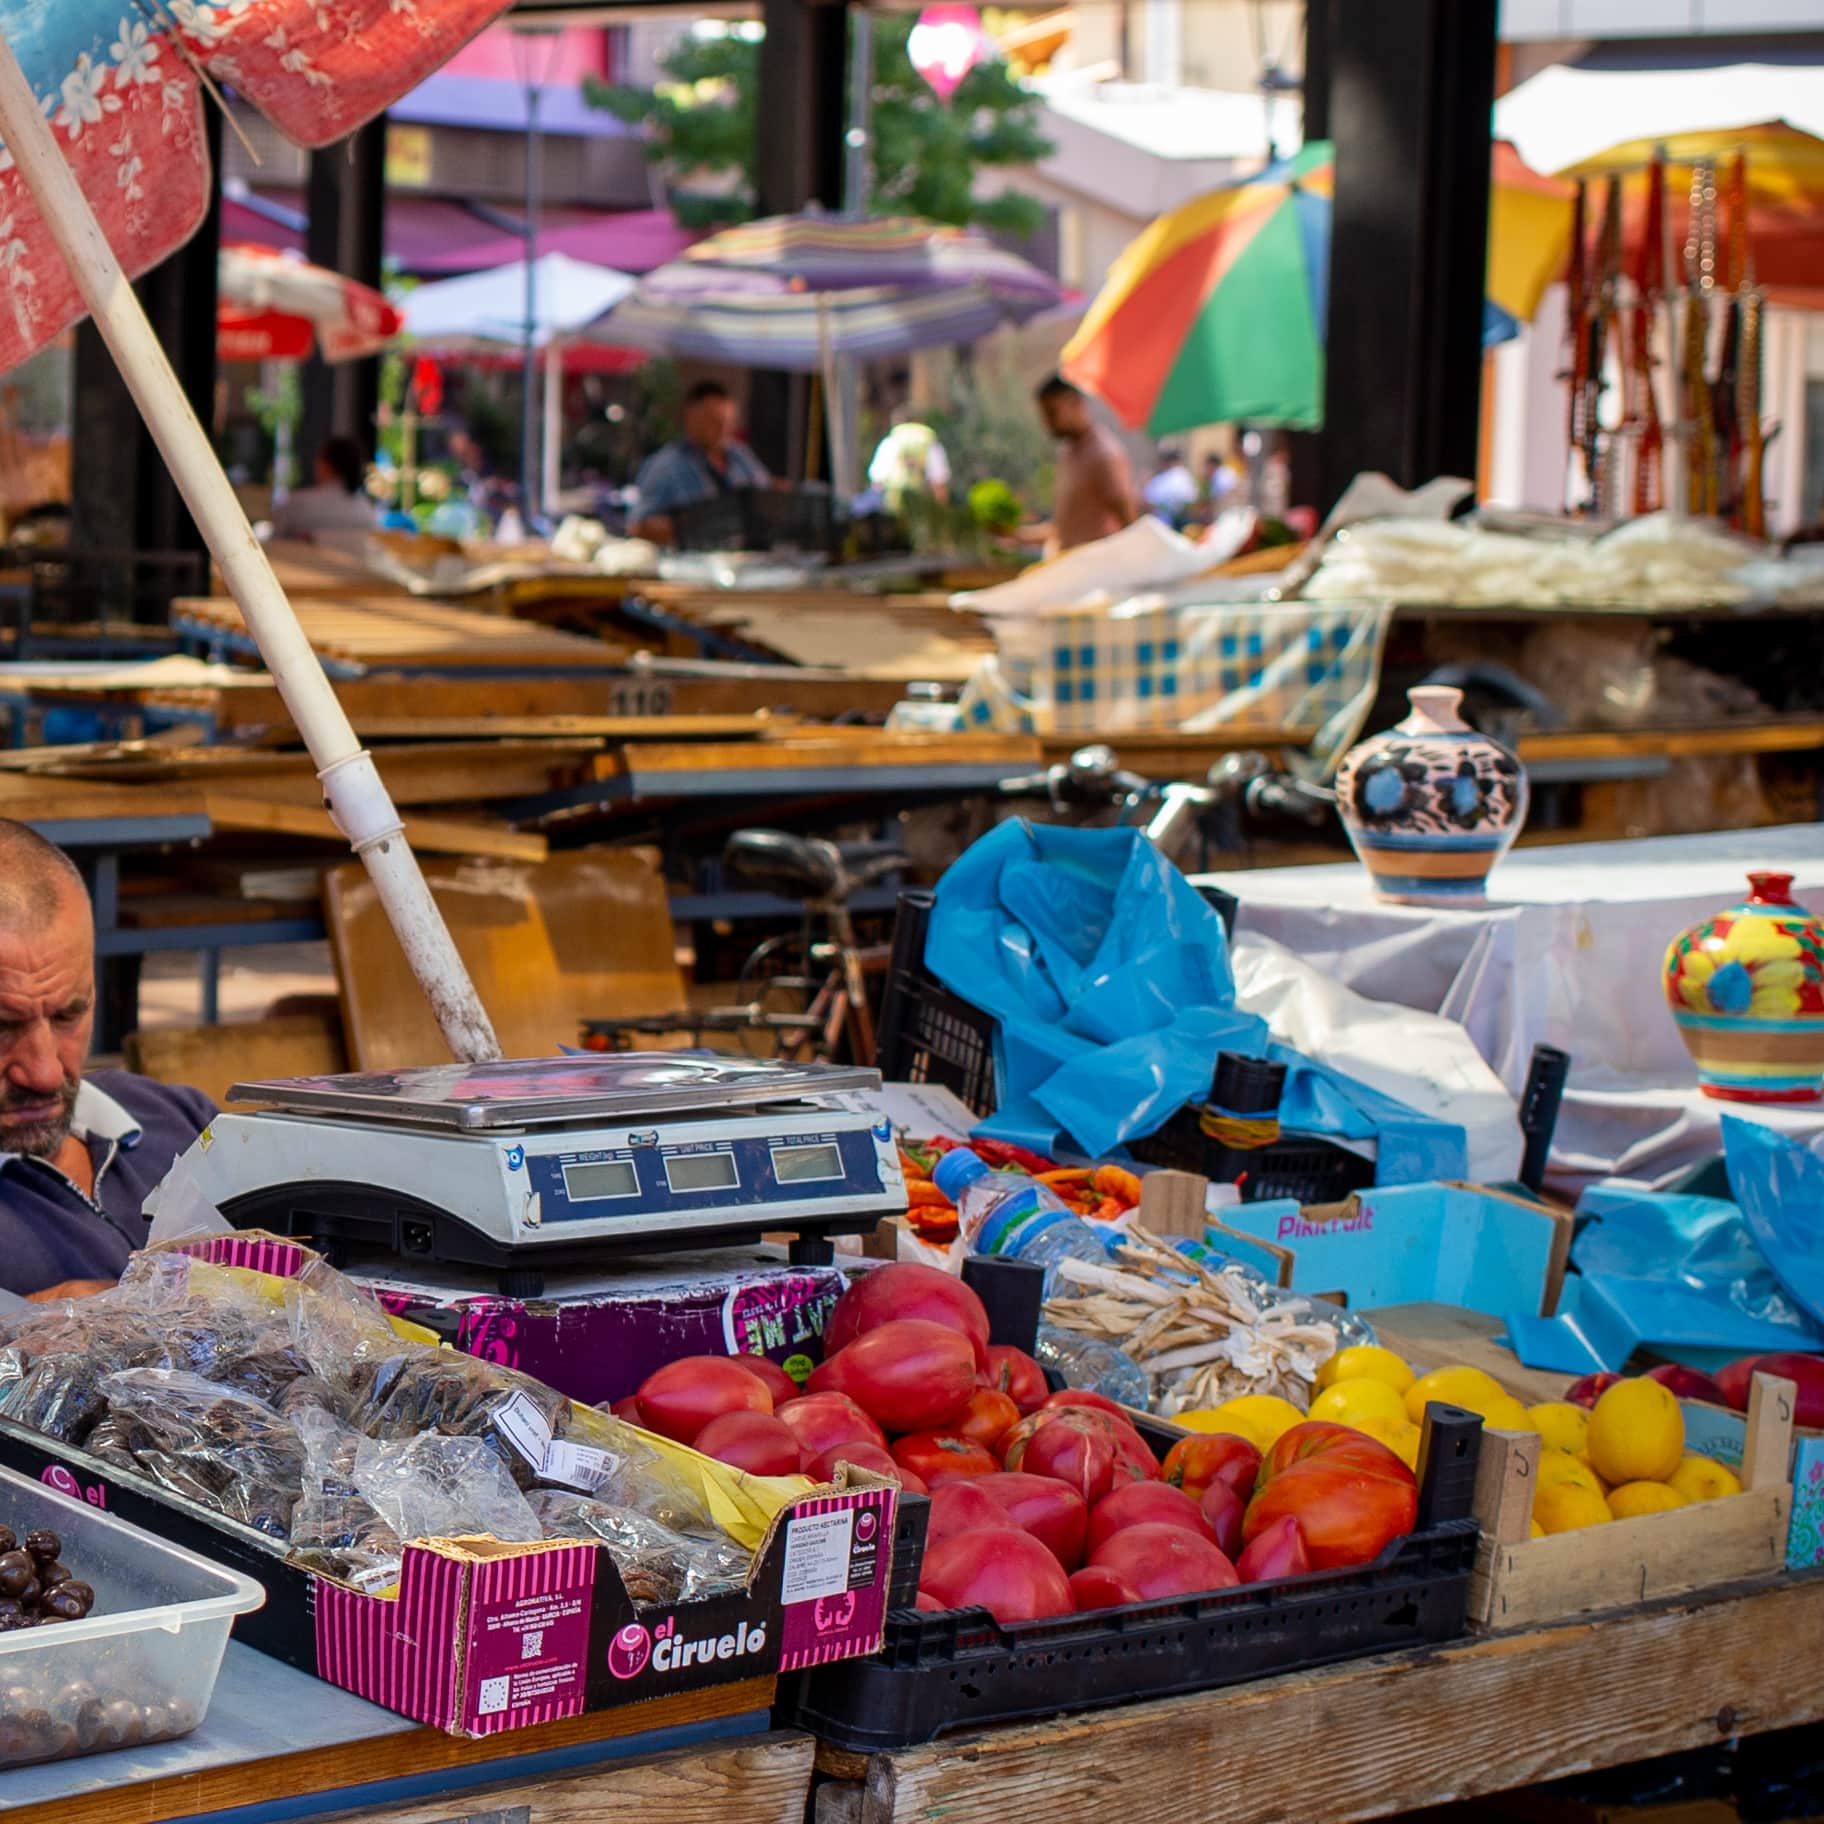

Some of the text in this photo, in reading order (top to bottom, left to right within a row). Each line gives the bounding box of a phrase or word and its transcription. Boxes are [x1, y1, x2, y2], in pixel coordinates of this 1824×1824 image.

[86, 1483, 107, 1509] el
[654, 1615, 674, 1639] el
[652, 1621, 766, 1672] Ciruelo
